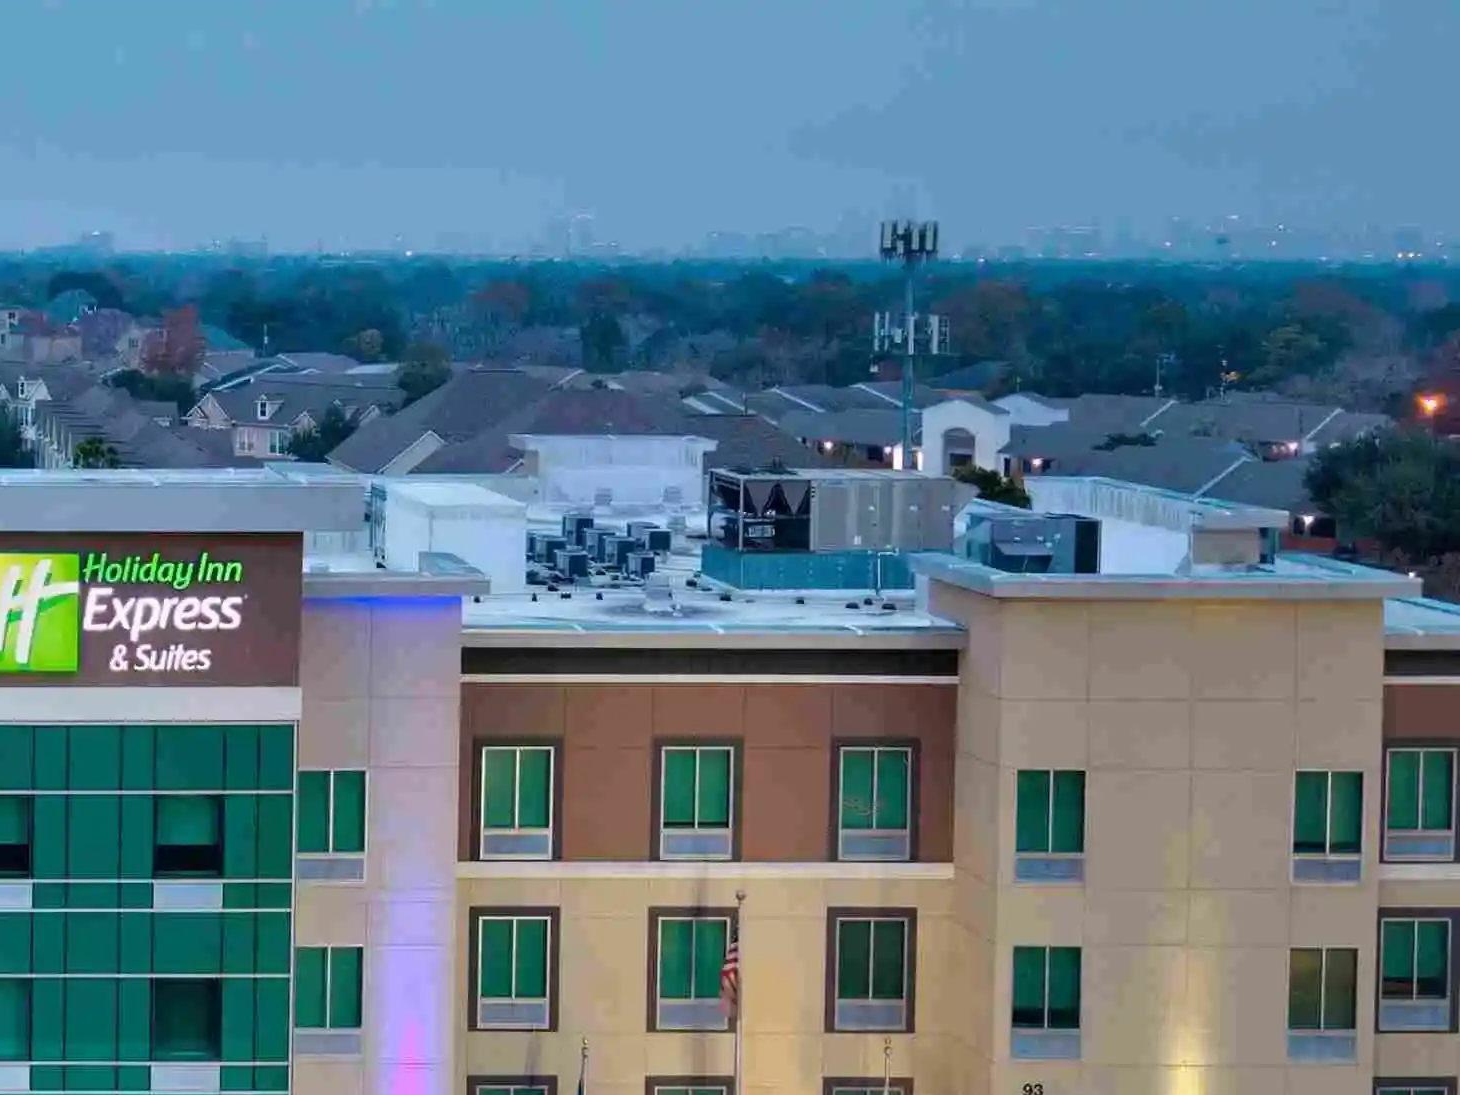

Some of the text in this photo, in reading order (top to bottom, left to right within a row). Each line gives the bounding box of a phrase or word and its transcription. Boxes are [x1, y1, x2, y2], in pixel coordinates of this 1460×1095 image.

[82, 552, 243, 589] Holiday Inn
[82, 587, 243, 642] Express
[109, 643, 212, 672] & Suites
